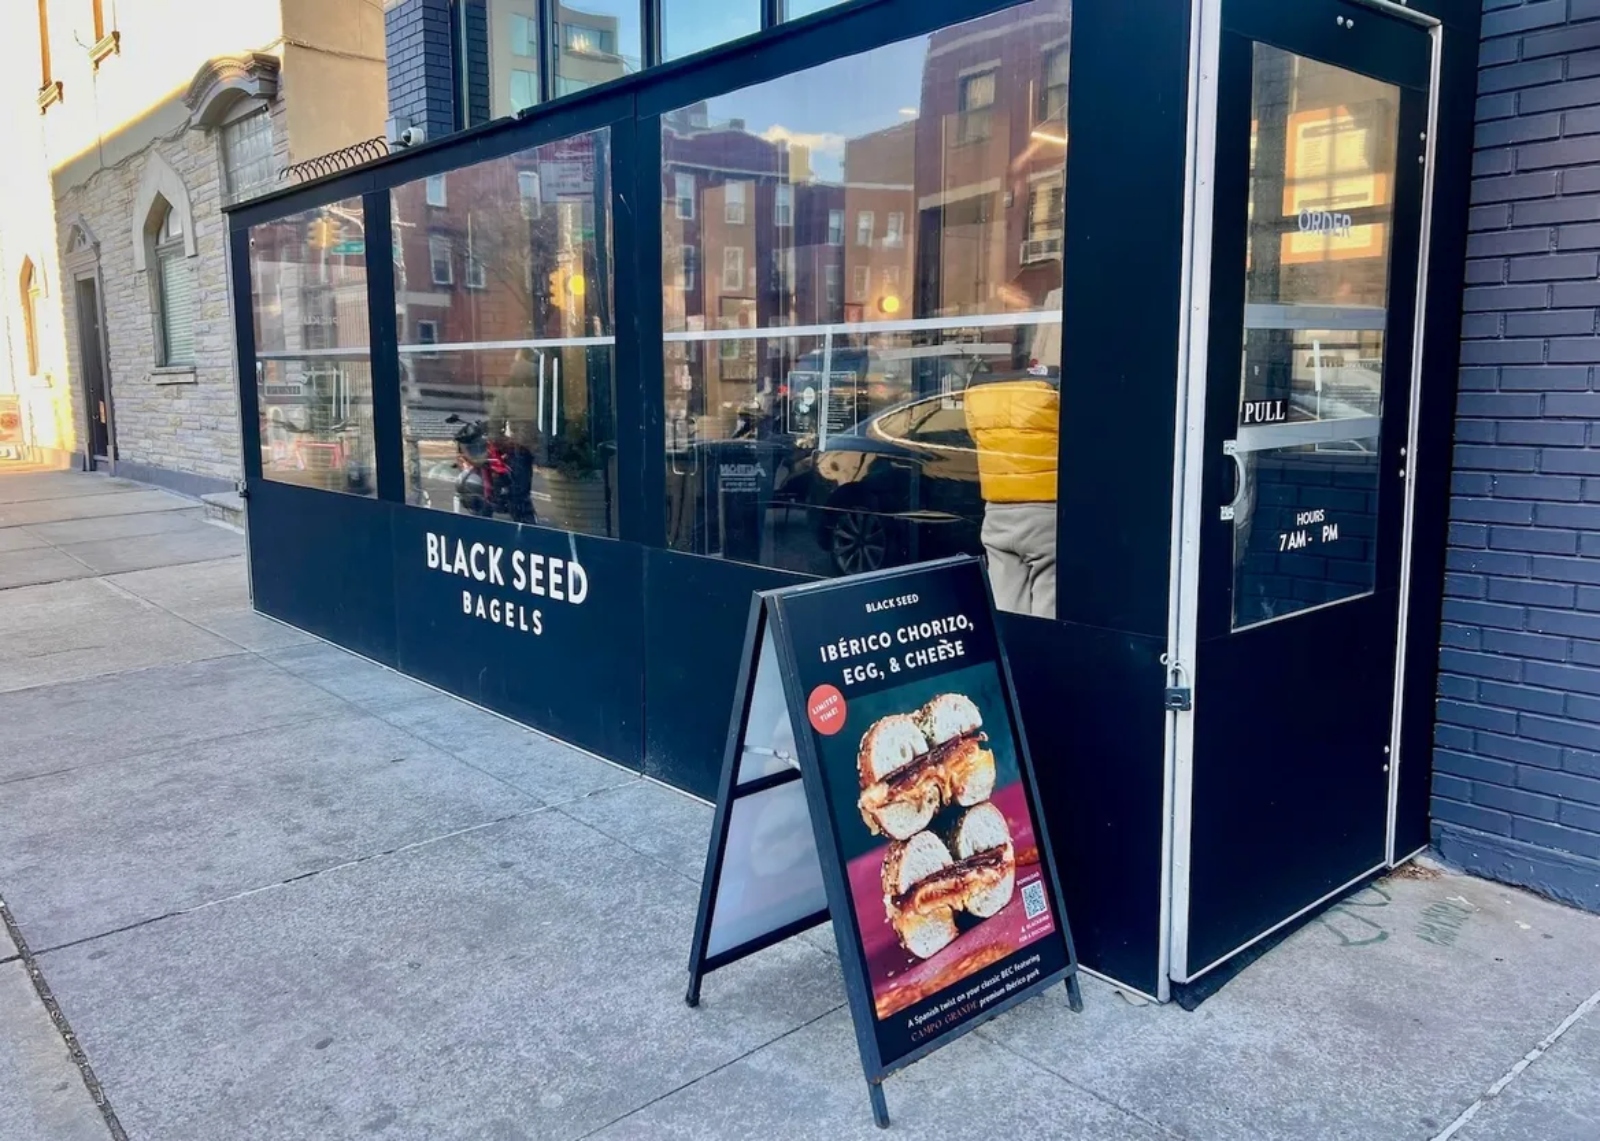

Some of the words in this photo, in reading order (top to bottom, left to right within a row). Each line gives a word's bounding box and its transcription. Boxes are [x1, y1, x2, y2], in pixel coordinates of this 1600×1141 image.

[1298, 209, 1351, 238] ORDER
[1244, 400, 1286, 423] PULL
[1296, 508, 1325, 526] HOURS
[1322, 523, 1338, 543] PM
[426, 532, 505, 586] BLACK
[511, 550, 588, 604] SEED
[462, 590, 543, 635] BAGELS
[865, 599, 896, 614] BLACK
[895, 593, 919, 608] SEED
[820, 631, 891, 663] IBÉRICO
[897, 614, 975, 644] CHORIZO,
[843, 662, 885, 686] EGG,
[889, 657, 901, 674] &
[905, 639, 965, 669] CHEESE
[811, 695, 838, 715] LIMITED
[907, 1019, 914, 1028] A
[914, 1005, 940, 1025] Spanish
[939, 997, 957, 1011] twist
[956, 993, 966, 1002] on
[966, 985, 980, 999] your
[981, 974, 1001, 990] classic
[1001, 966, 1014, 979] BEC
[1014, 954, 1041, 971] featuring
[979, 988, 1006, 1008] premium
[1026, 968, 1040, 982] pork
